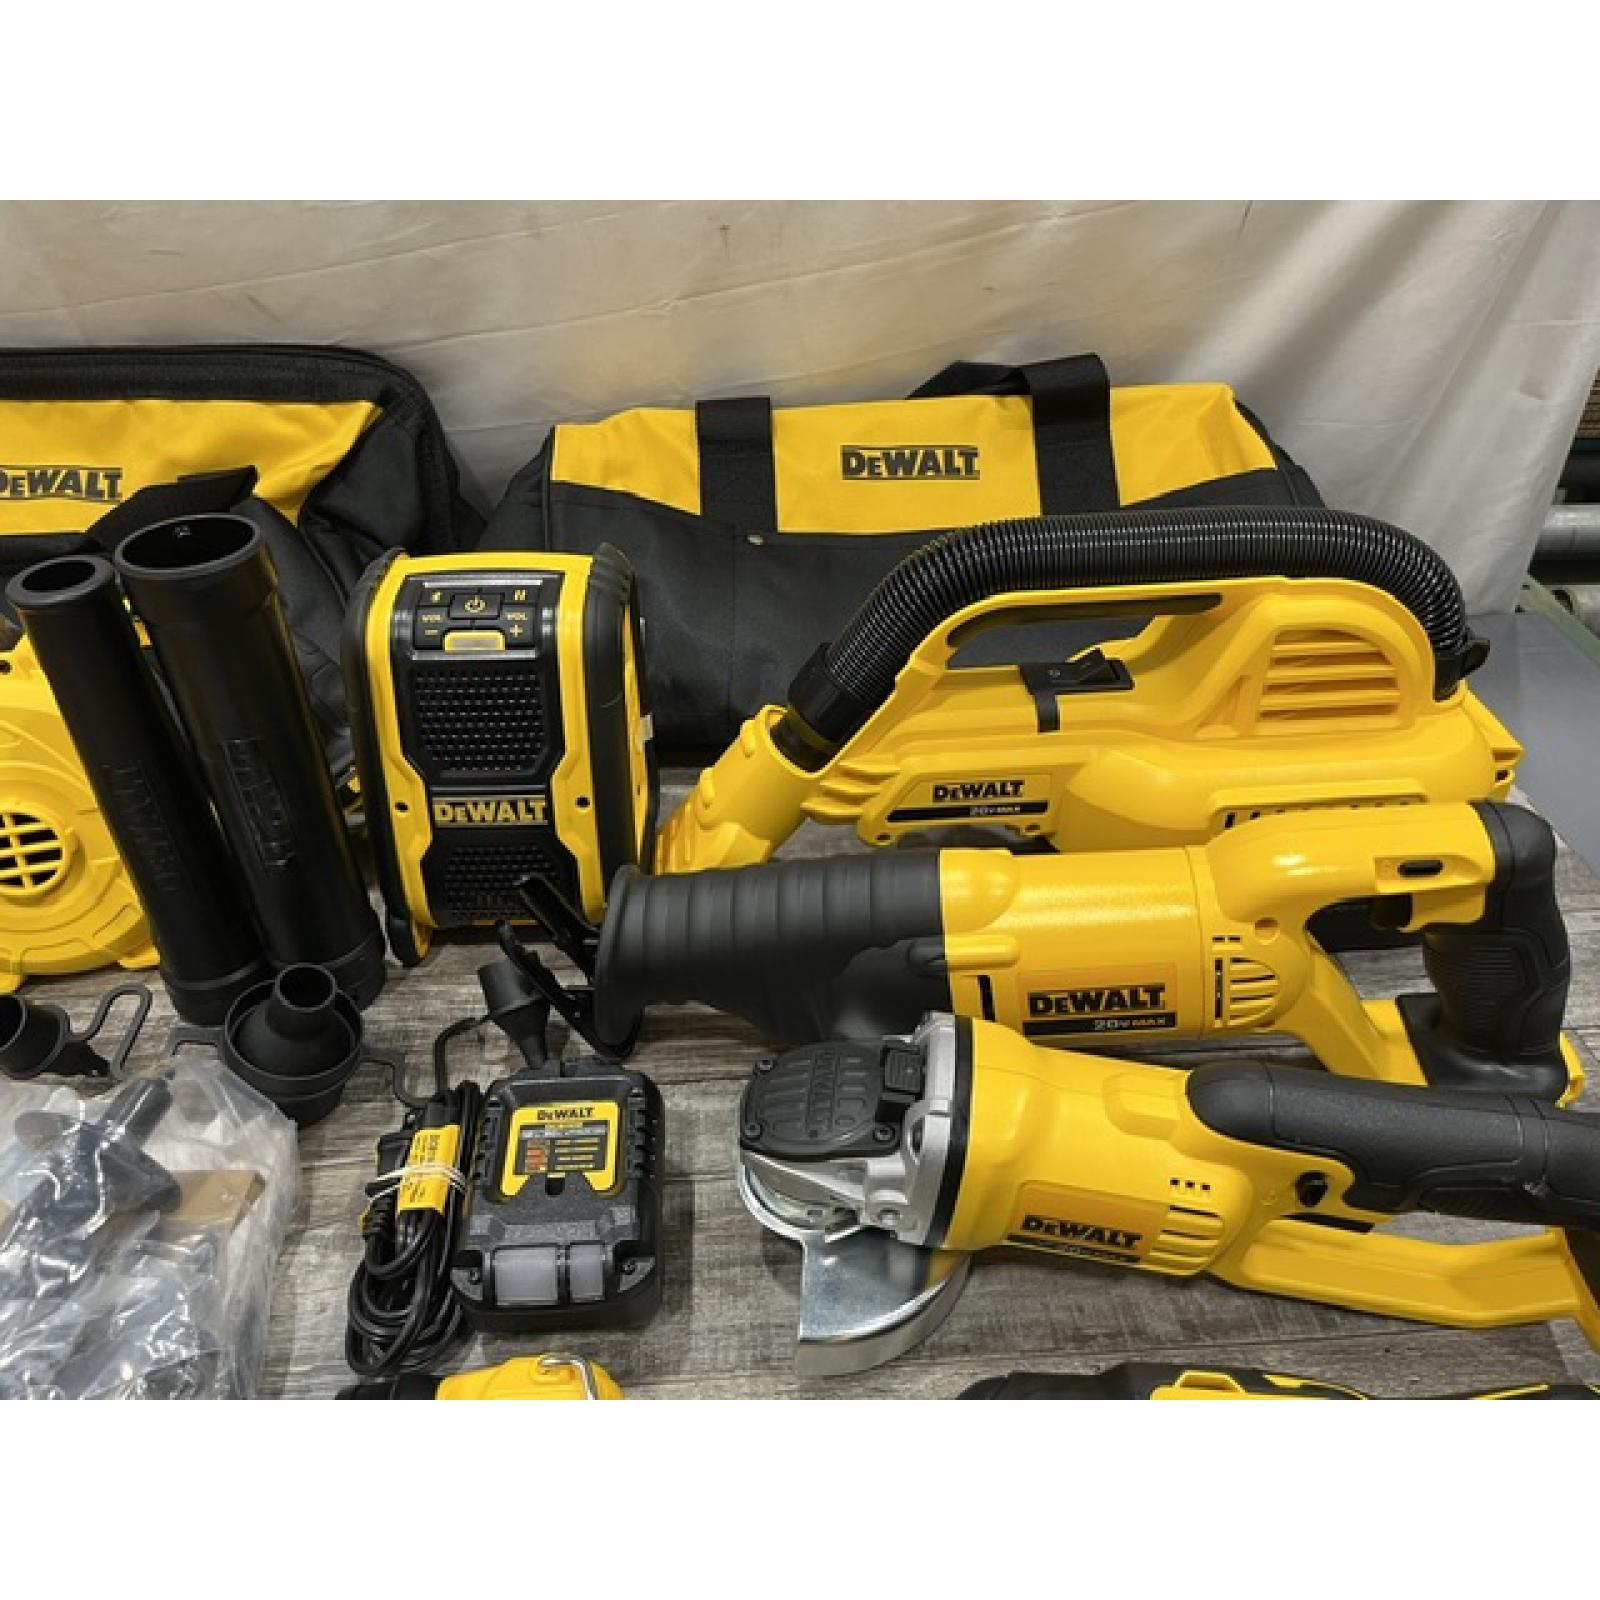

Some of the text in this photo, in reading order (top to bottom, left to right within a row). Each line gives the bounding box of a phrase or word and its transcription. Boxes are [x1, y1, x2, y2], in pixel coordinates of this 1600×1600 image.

[841, 445, 980, 480] DEWALT
[932, 780, 1024, 802] DEWALT
[433, 796, 548, 827] DEWALT
[1028, 983, 1166, 1018] DEWALT
[537, 1107, 595, 1121] DEWALT
[1022, 1214, 1143, 1249] DEWALT
